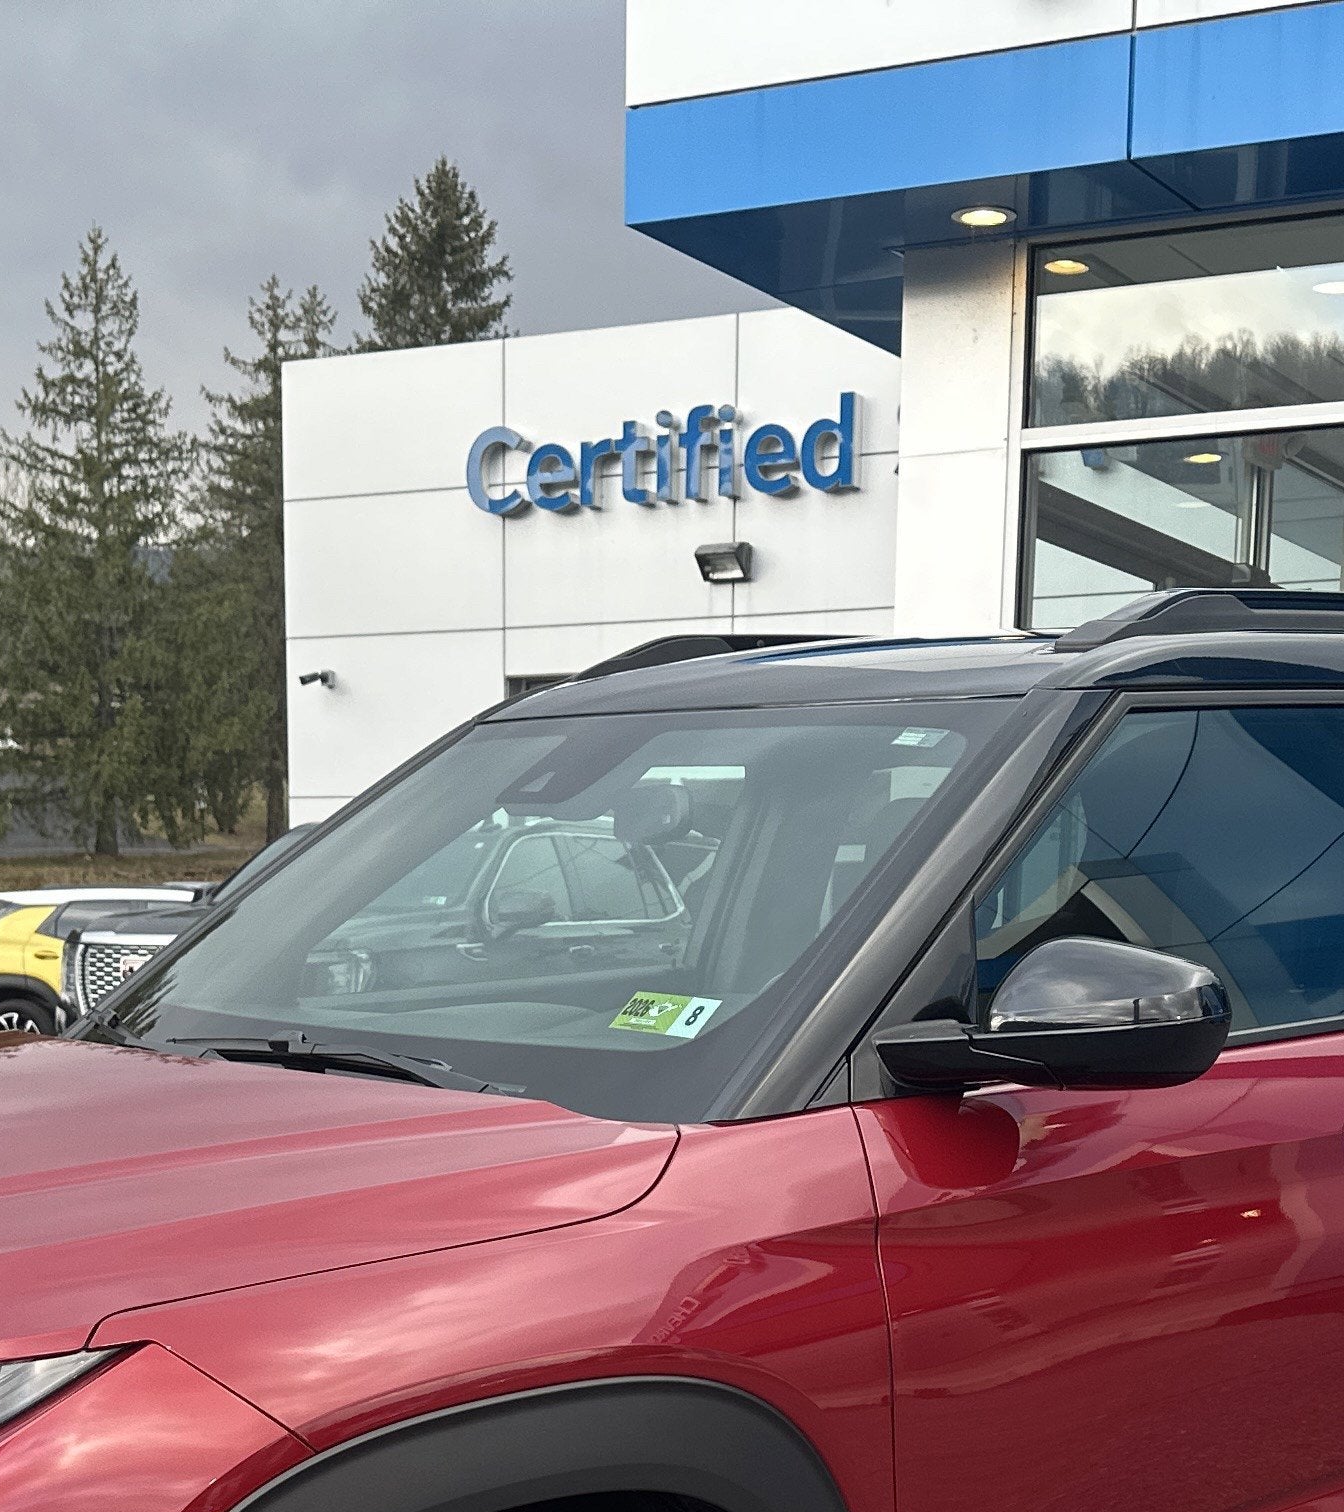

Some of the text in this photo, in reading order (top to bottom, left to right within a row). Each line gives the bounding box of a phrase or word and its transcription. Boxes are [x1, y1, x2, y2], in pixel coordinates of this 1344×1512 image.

[467, 392, 859, 517] Certified
[622, 998, 656, 1017] 2026
[684, 1005, 706, 1027] 8
